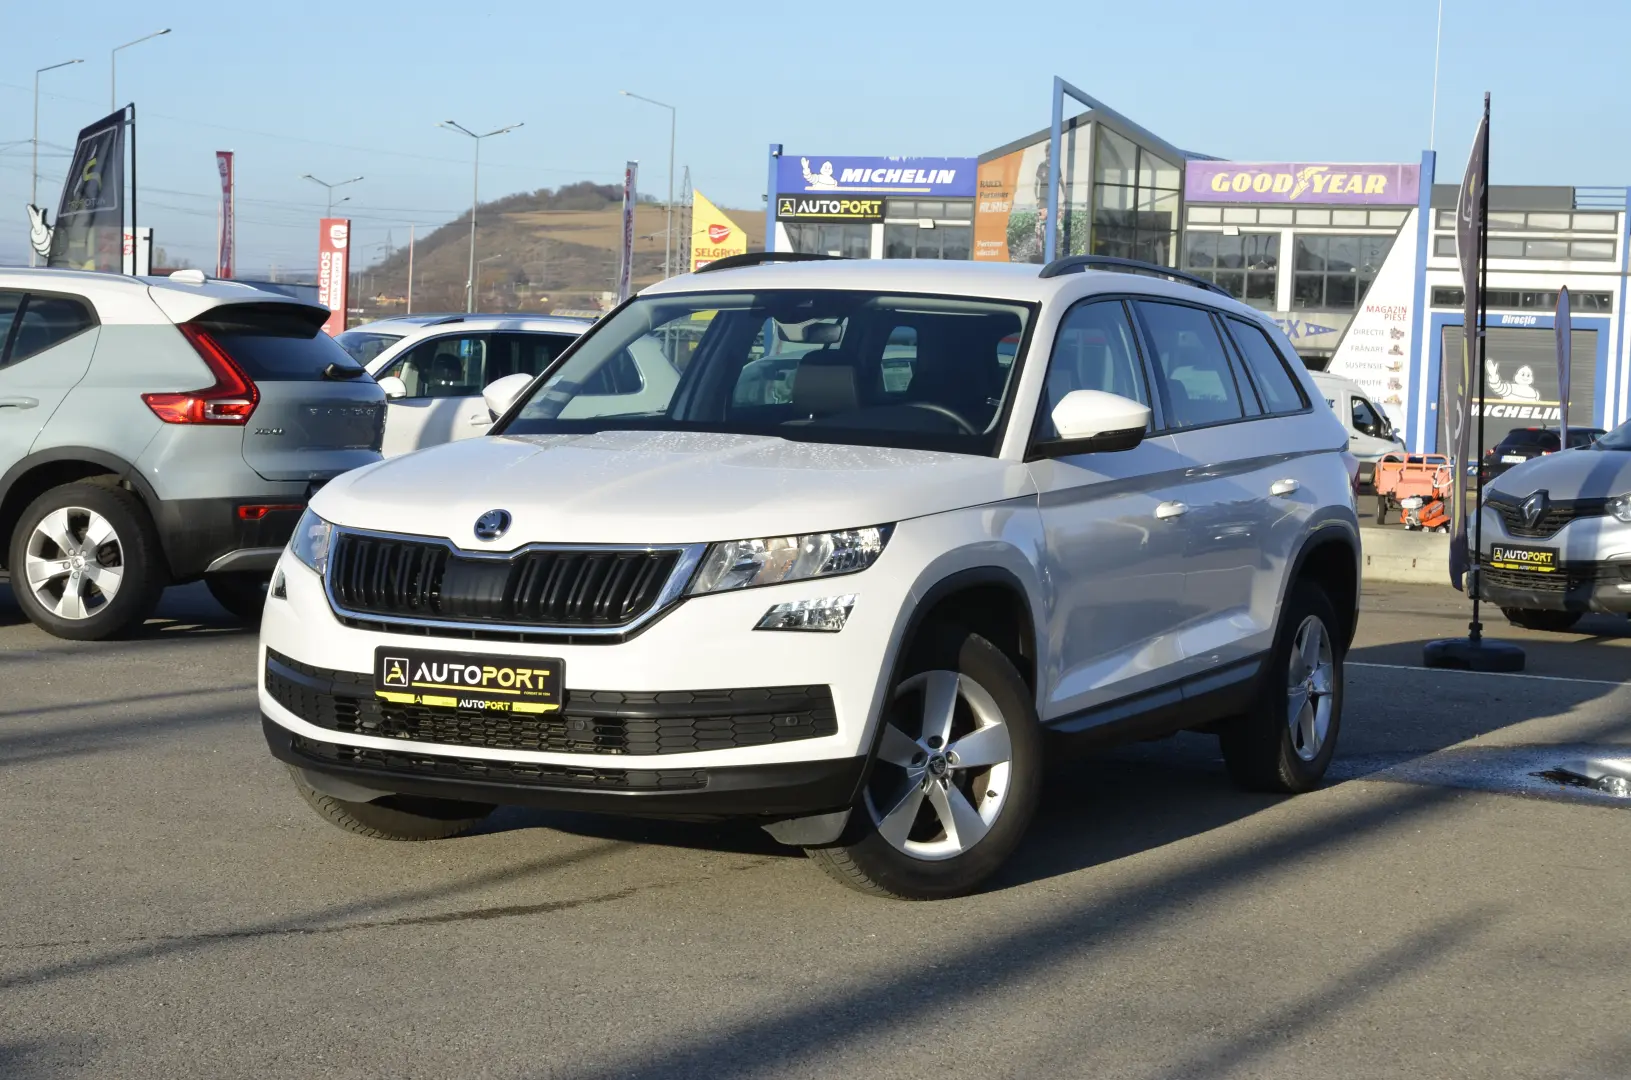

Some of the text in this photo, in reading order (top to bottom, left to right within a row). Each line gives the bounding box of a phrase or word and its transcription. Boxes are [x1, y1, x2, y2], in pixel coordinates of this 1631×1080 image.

[840, 168, 957, 184] MICHELIN
[798, 200, 882, 214] AUTOPORT
[1366, 305, 1407, 314] MAGAZIN
[1384, 313, 1407, 321] PIESE
[1504, 549, 1553, 563] AUTOPORT
[414, 661, 550, 689] AUTOPORT
[459, 699, 511, 711] AUTOPORT
